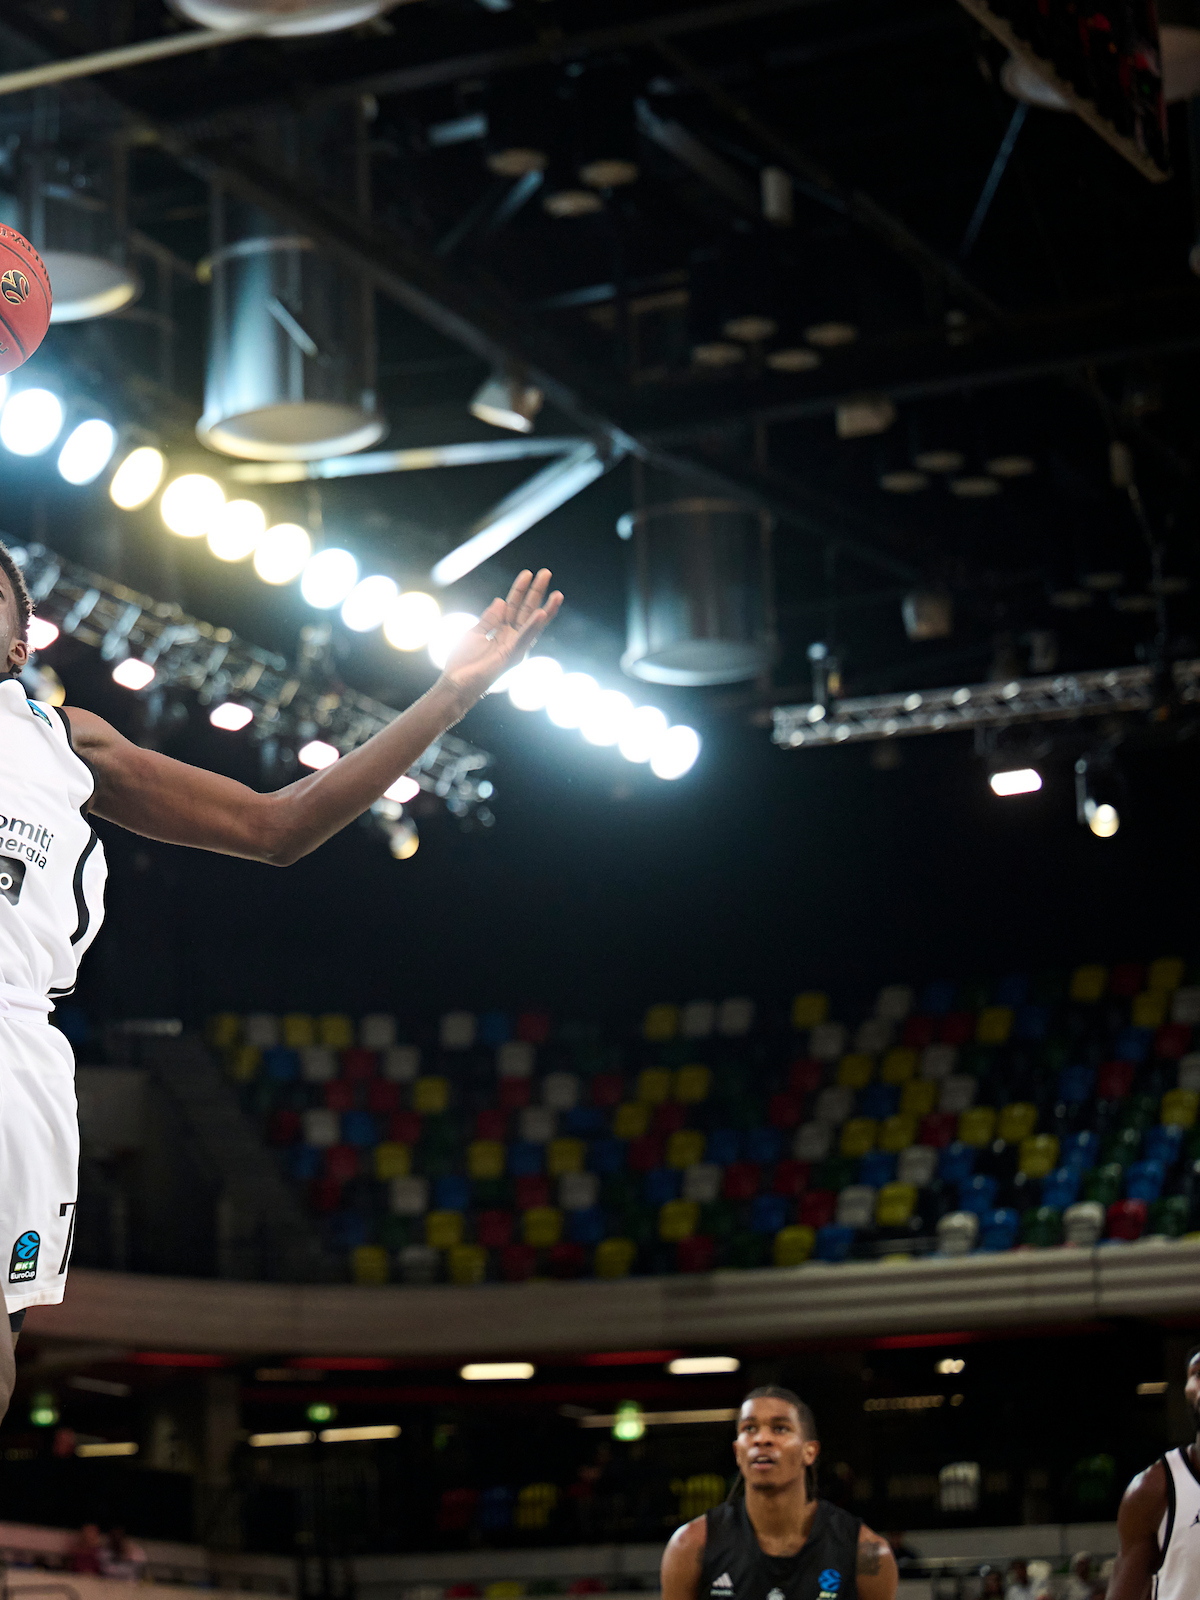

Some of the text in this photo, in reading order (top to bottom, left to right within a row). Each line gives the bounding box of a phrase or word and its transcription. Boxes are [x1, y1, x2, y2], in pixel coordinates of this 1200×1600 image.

[57, 1202, 77, 1275] 7
[15, 1261, 35, 1271] BKT
[10, 1271, 35, 1280] EuroCup
